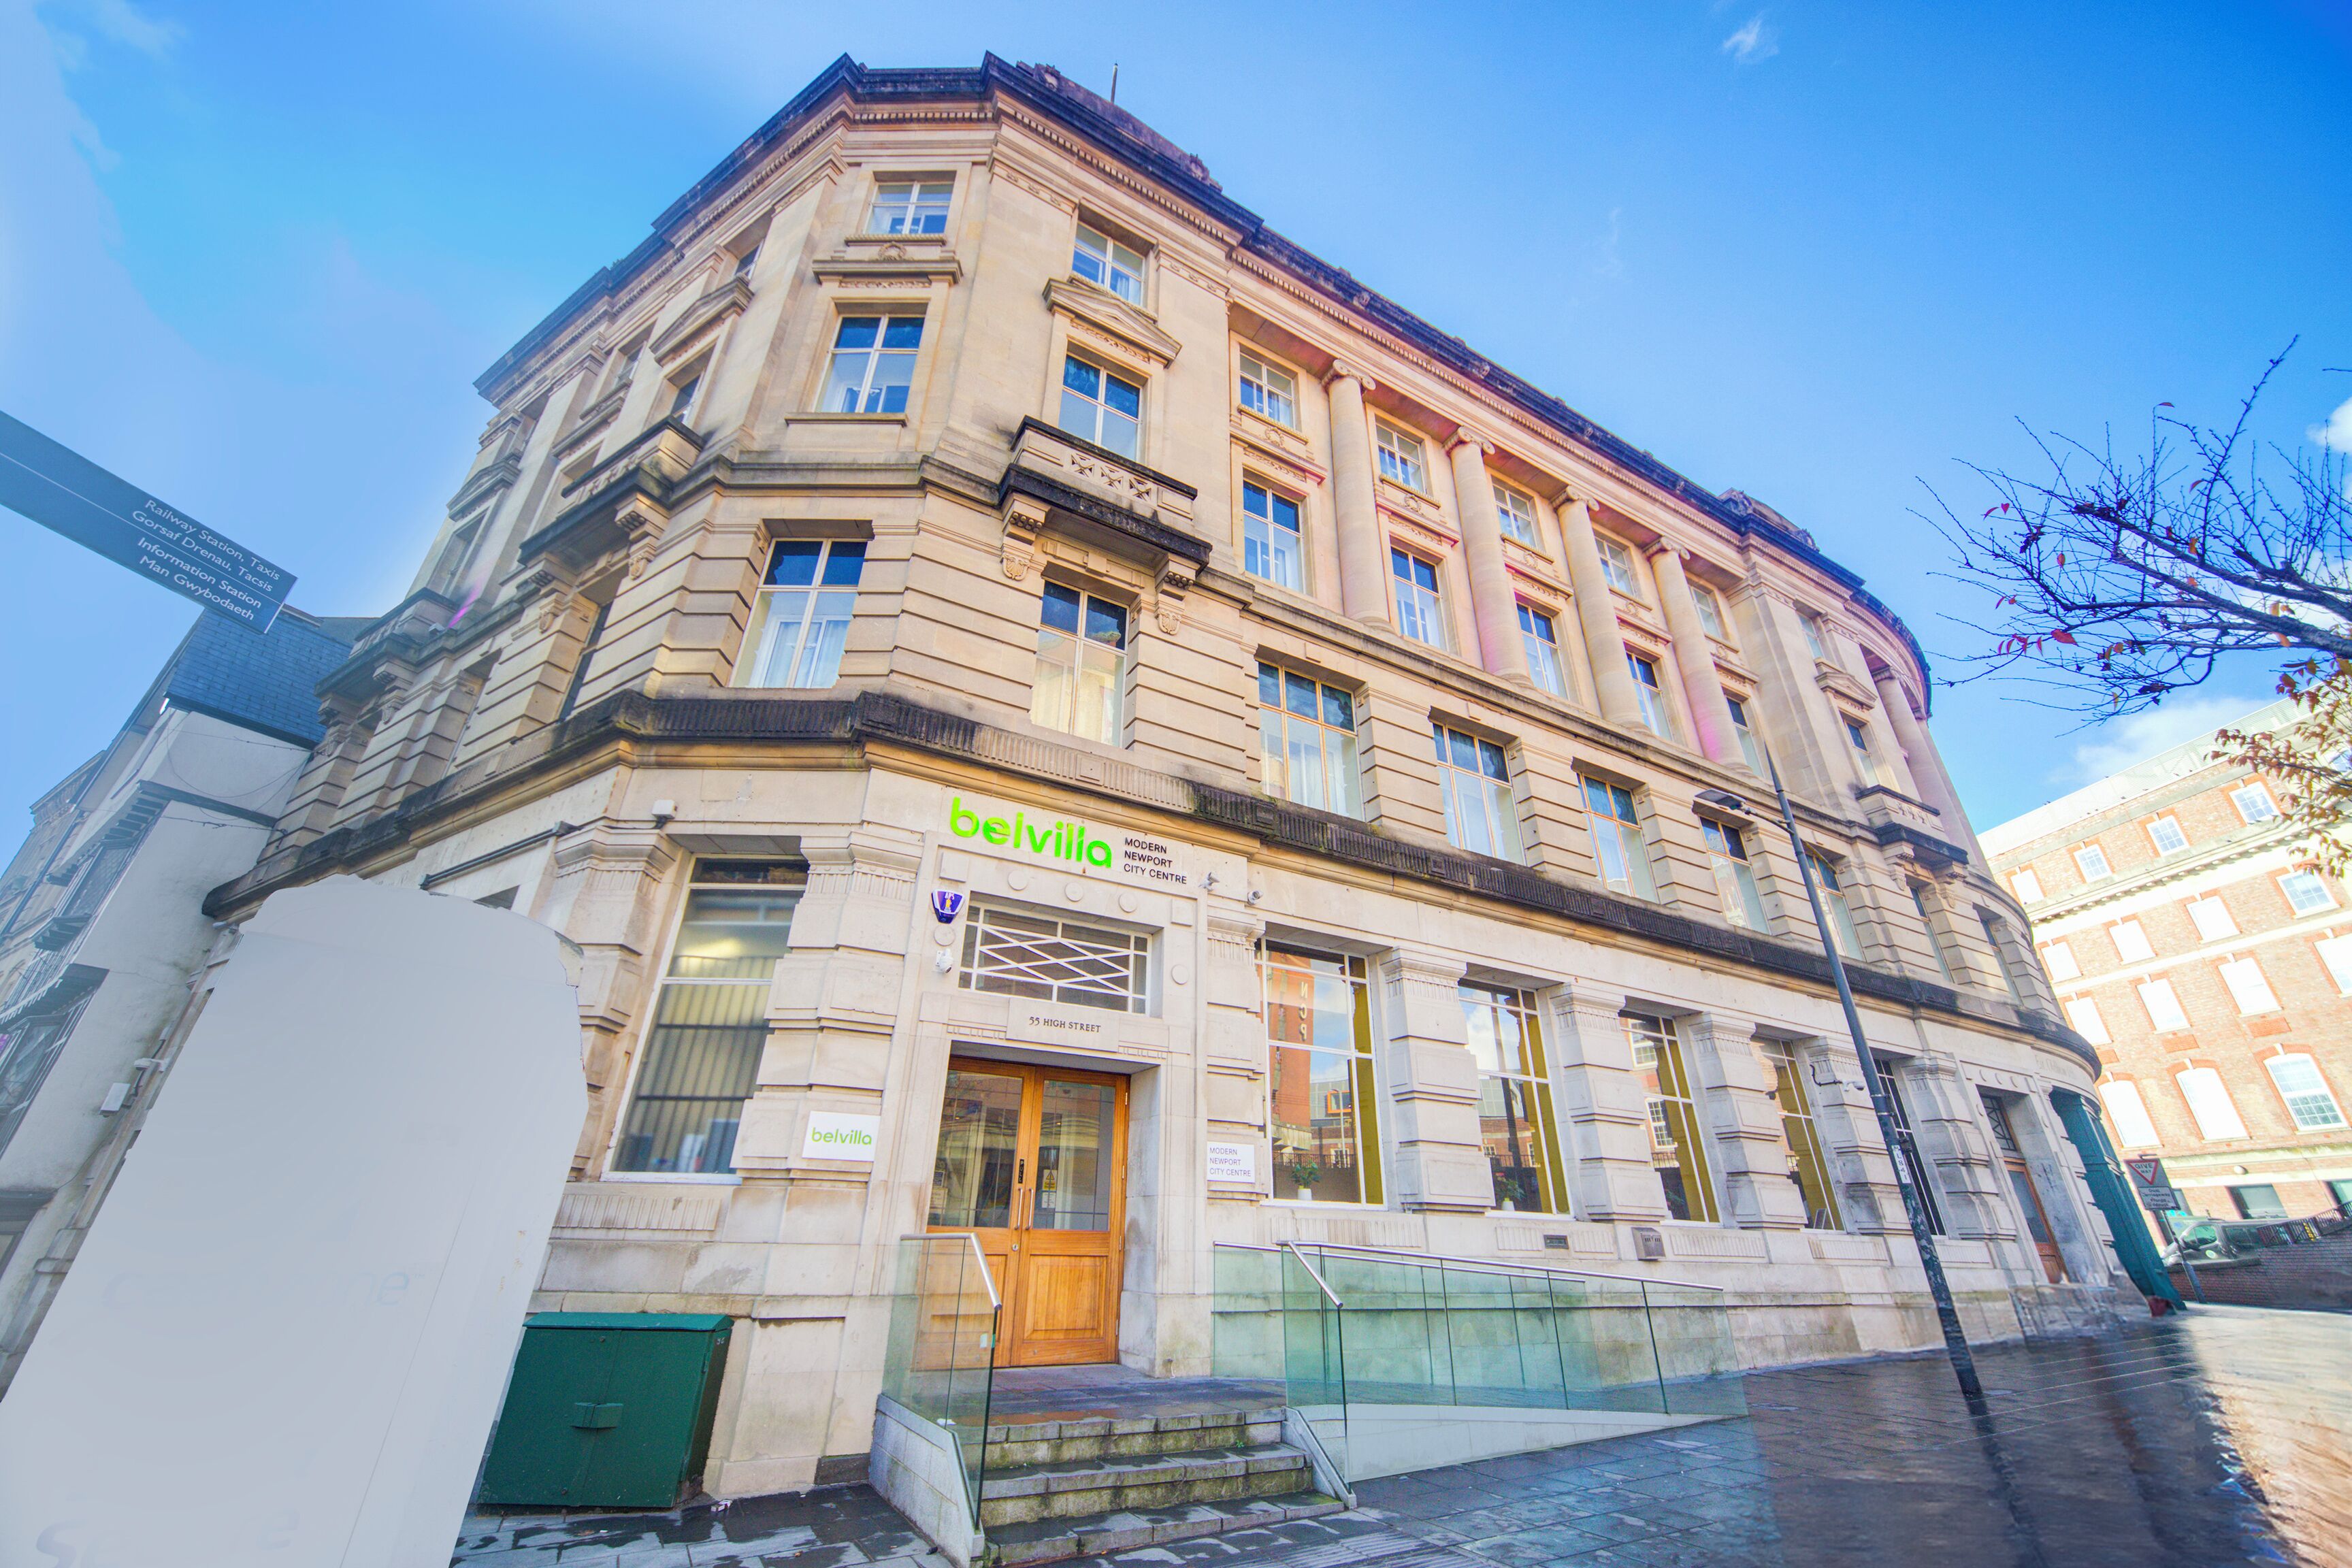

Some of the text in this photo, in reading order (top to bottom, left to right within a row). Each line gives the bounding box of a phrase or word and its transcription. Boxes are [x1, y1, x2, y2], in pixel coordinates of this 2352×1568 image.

[145, 500, 280, 581] Railway Station, Taxis
[133, 510, 273, 592] Gorsaf Drenau, Tacsis
[137, 537, 261, 608] Information Station
[139, 555, 255, 620] Man Gwybodaeth
[950, 796, 1112, 868] belvilla
[1124, 836, 1167, 854] MODERN
[1124, 850, 1173, 868] NEWPORT
[1124, 863, 1187, 885] CITY CENTRE
[1029, 1016, 1101, 1032] 55 HIGH STREET
[811, 1127, 872, 1145] belvilla
[1209, 1158, 1241, 1166] NEWPORT
[1226, 1169, 1251, 1177] CENTRE
